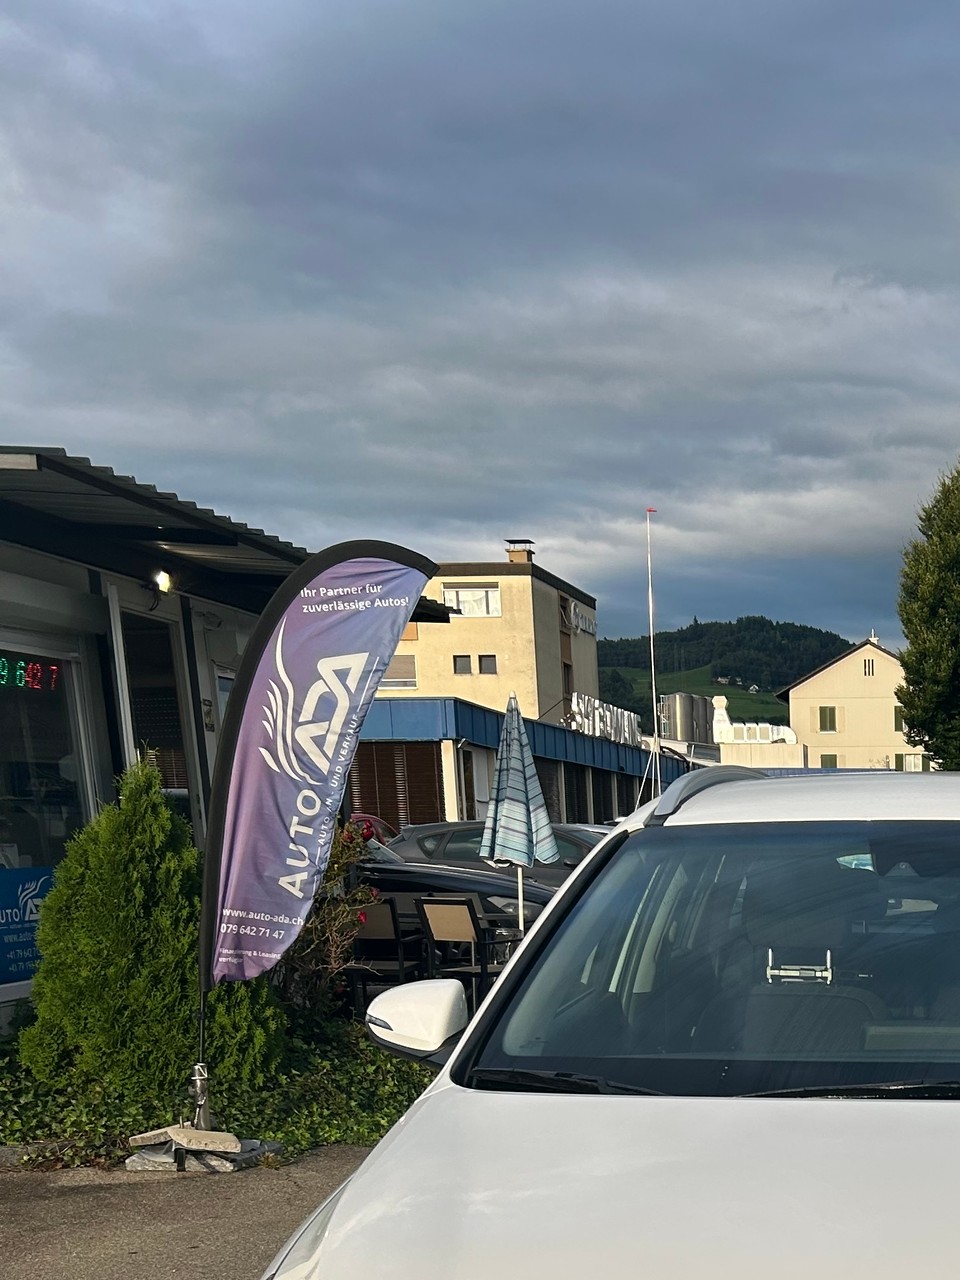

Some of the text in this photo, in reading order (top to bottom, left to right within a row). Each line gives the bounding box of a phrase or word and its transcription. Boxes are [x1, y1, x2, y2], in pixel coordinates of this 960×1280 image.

[300, 583, 383, 598] Ihr Partner für
[302, 597, 409, 613] zuverlässige Autos!
[318, 816, 330, 845] AUTO
[330, 765, 343, 787] UND
[338, 714, 359, 762] VERKAUF
[277, 789, 322, 899] AUTO
[222, 907, 304, 926] www.auto-ada.ch
[220, 923, 285, 939] 079 642 71 47
